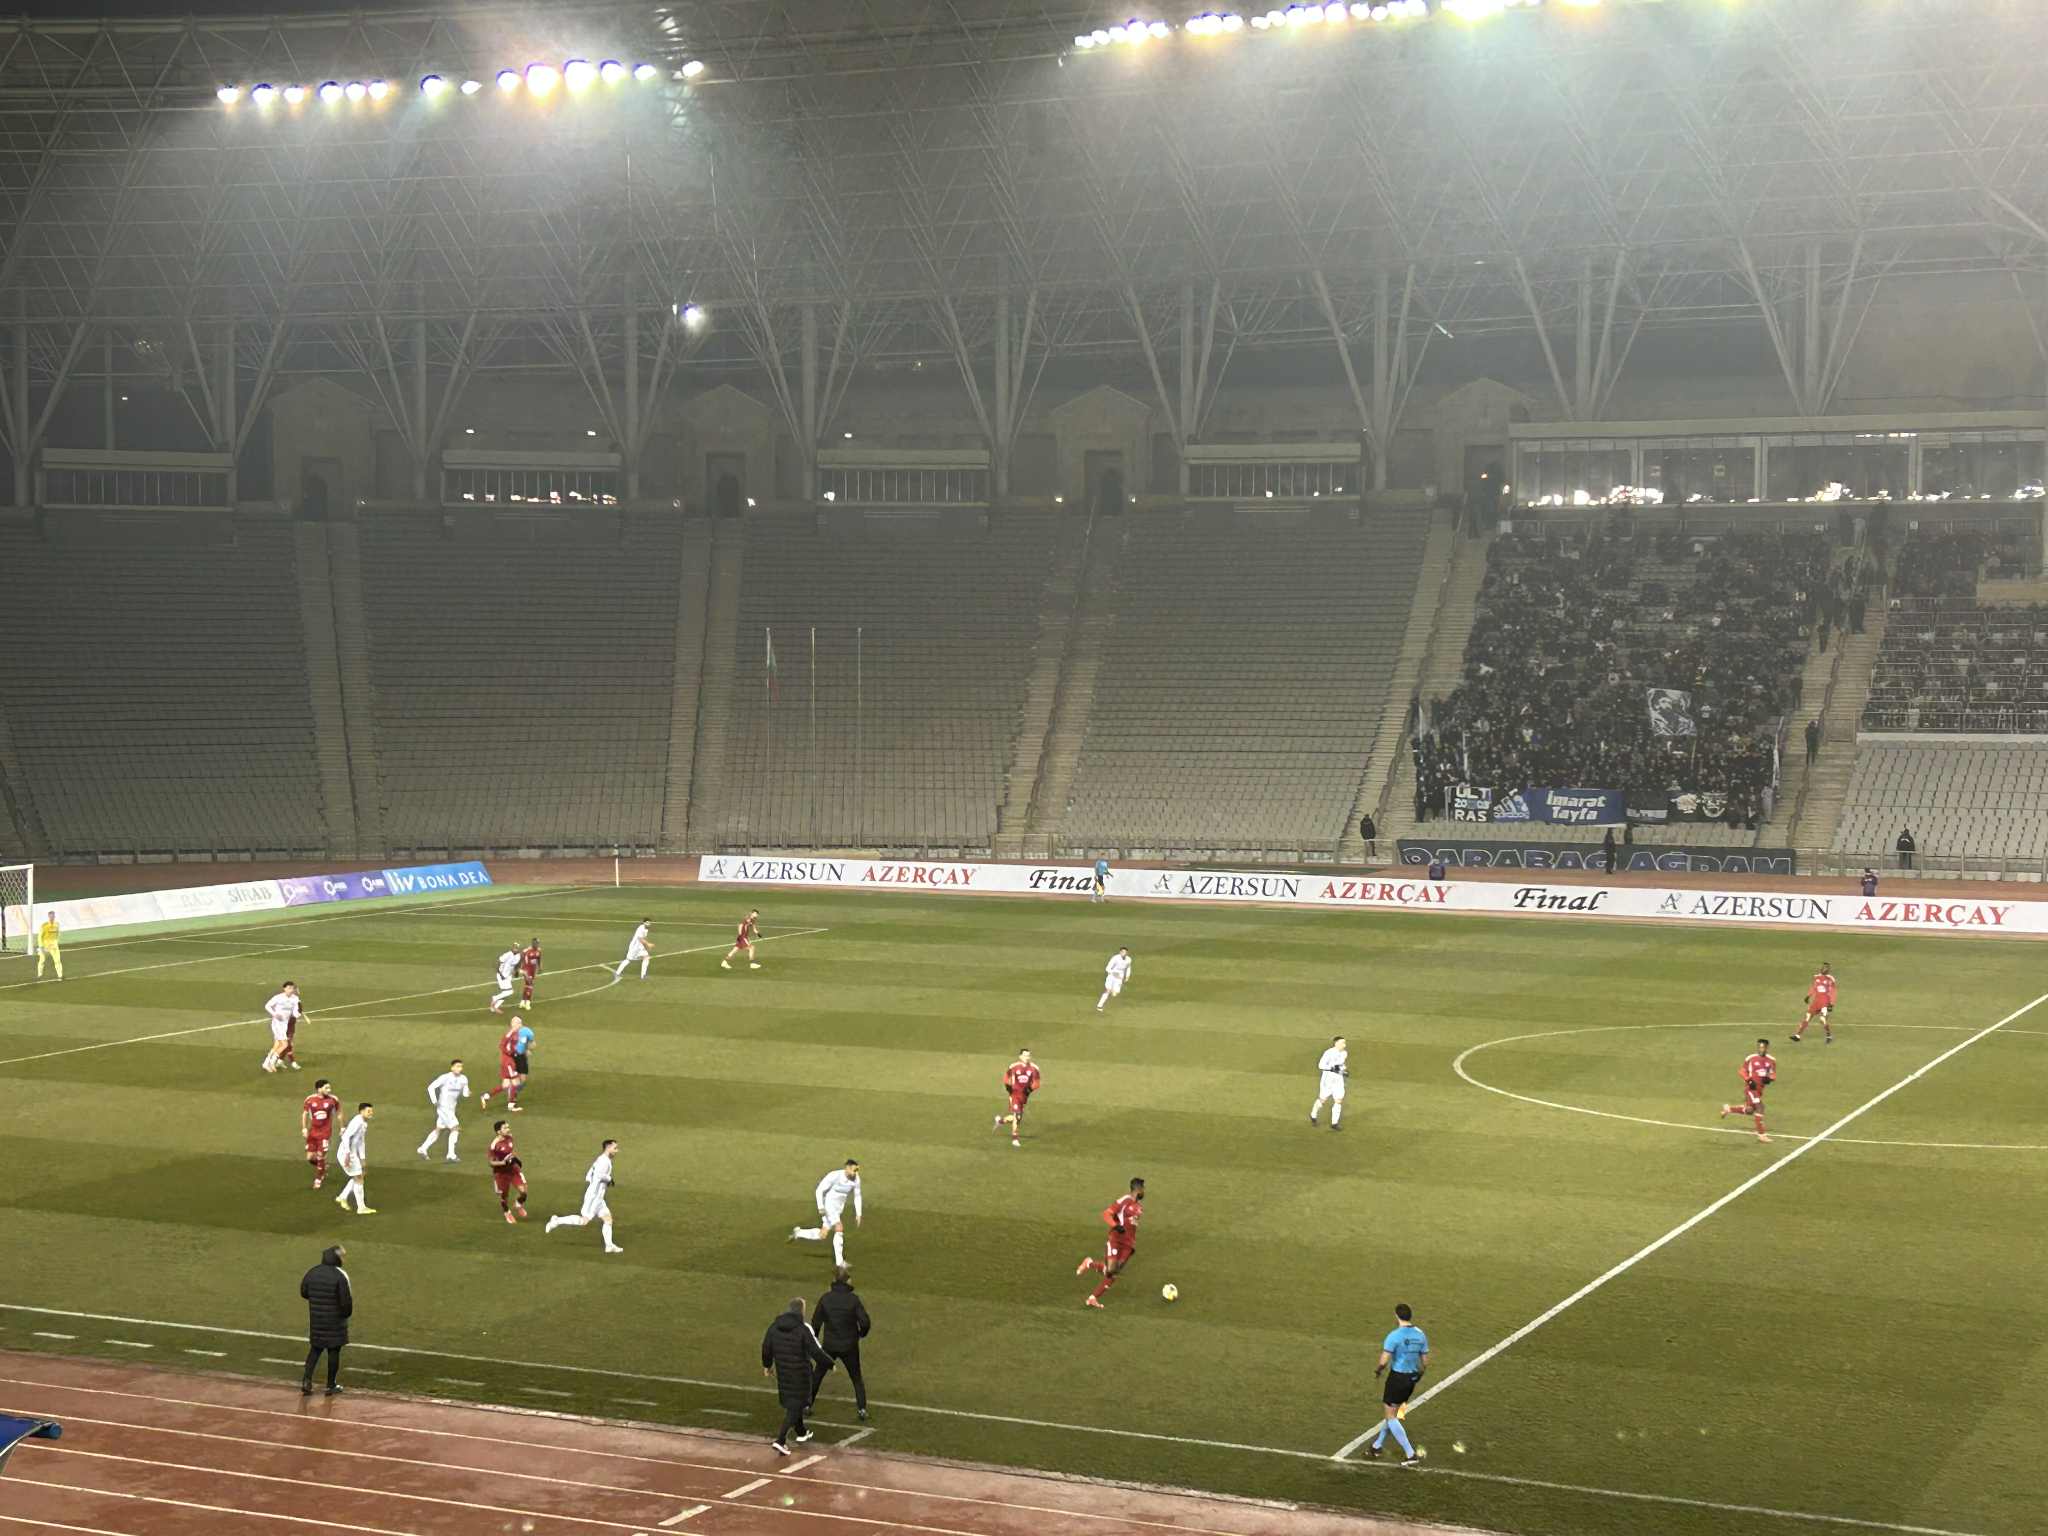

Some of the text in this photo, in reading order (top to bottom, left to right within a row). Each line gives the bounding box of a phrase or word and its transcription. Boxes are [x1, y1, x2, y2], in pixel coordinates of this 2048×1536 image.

[1454, 809, 1488, 822] RAS
[417, 871, 489, 889] BONA DEA
[733, 861, 846, 881] AZERSUN
[861, 866, 977, 888] AZERÇAY
[1029, 869, 1098, 891] Fina
[1179, 875, 1300, 897] AZERSUN
[1320, 882, 1454, 904] AZERÇAY
[1514, 887, 1607, 911] Final
[1689, 895, 1833, 920] AZERSUN
[1855, 901, 2010, 926] AZERÇAY
